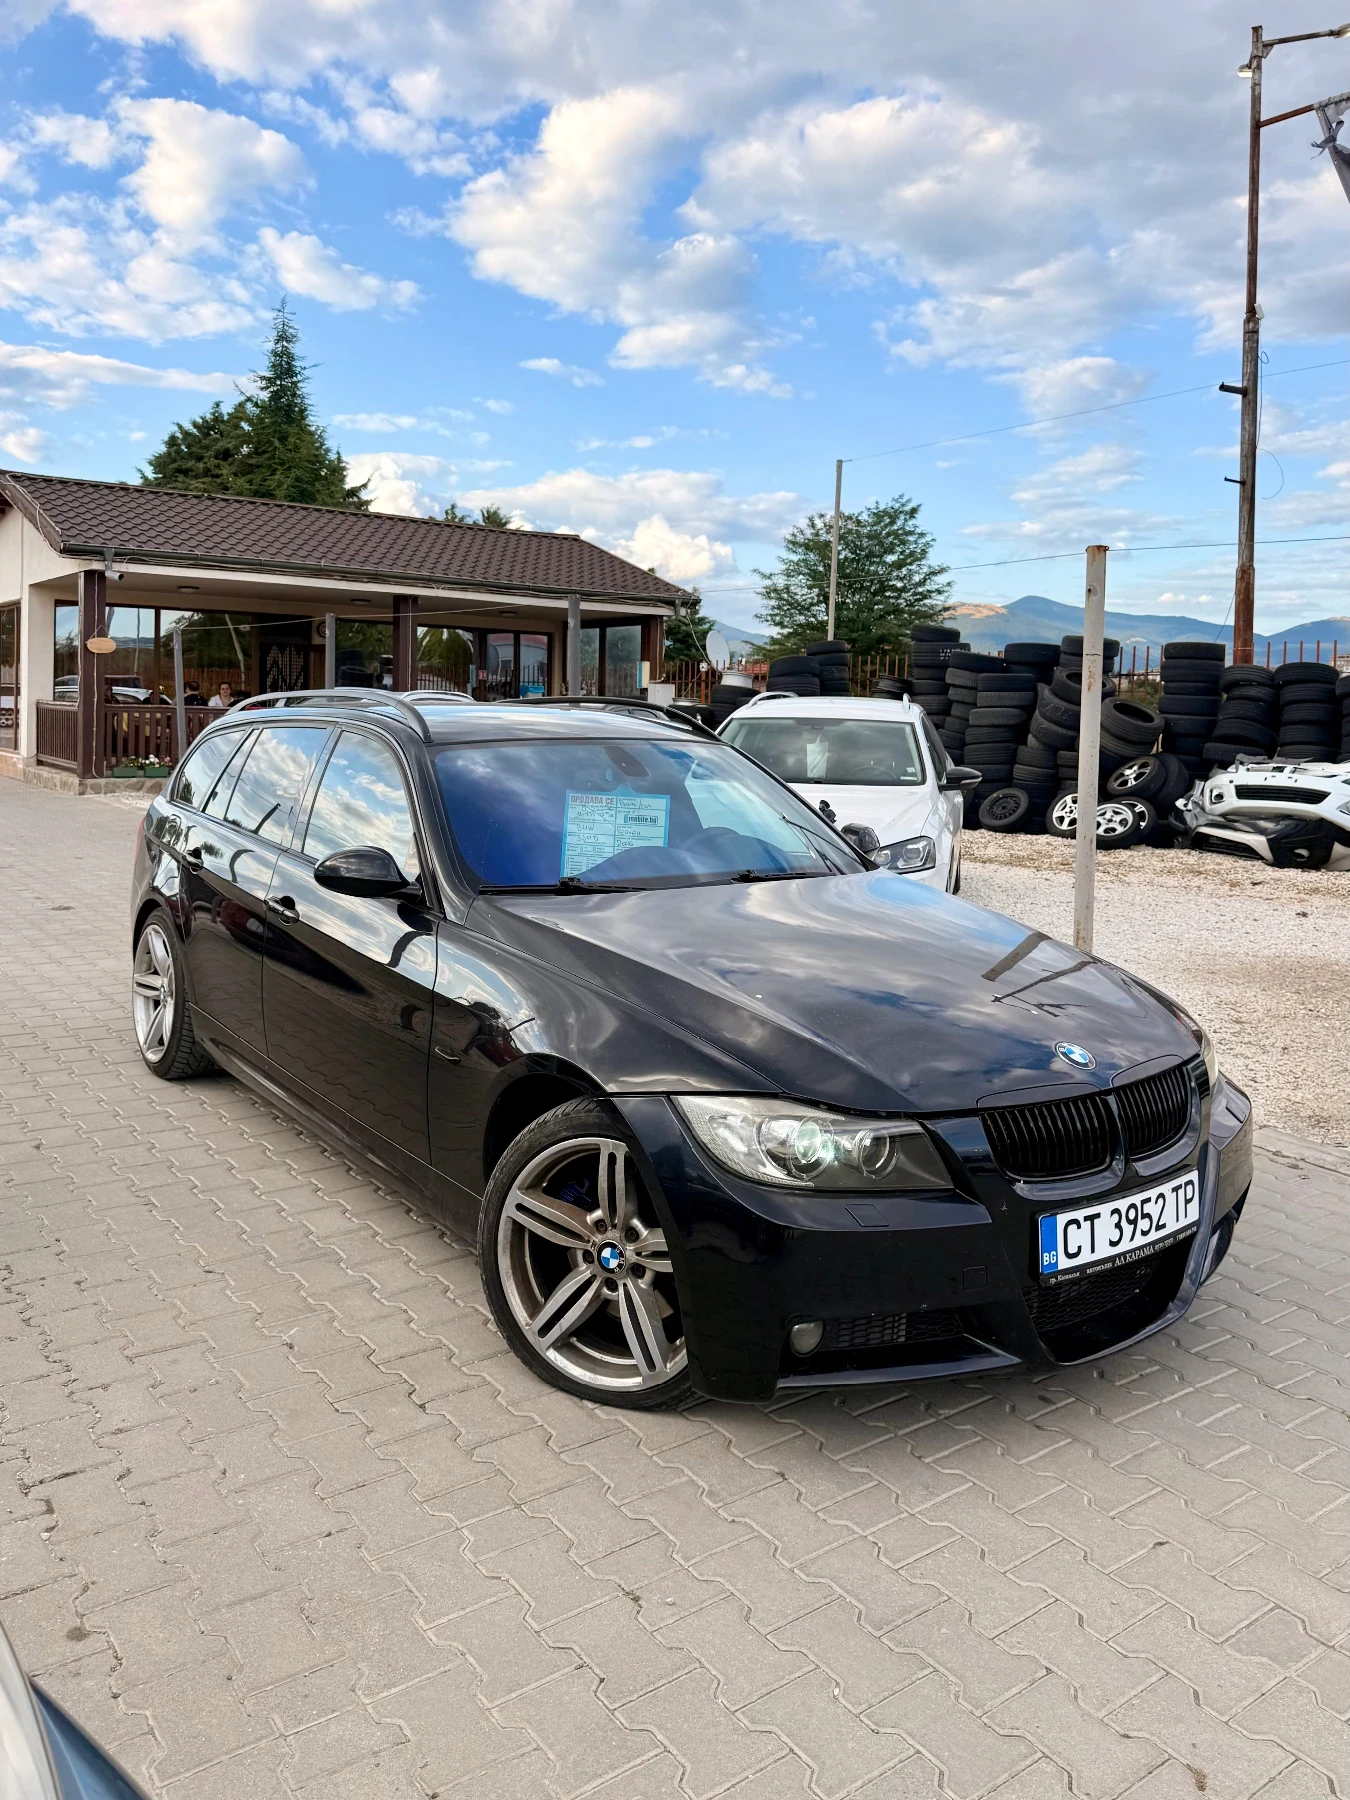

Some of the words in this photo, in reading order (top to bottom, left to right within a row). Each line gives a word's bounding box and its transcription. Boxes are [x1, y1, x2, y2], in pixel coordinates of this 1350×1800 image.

[570, 795, 604, 805] ПРОДАВА
[605, 797, 615, 805] СЕ
[628, 815, 657, 825] mobile.bg
[1062, 1213, 1101, 1260] CT
[1108, 1192, 1167, 1248] 3952
[1171, 1179, 1196, 1224] TP
[1043, 1251, 1057, 1266] BG
[1114, 1255, 1126, 1268] АЛ
[1125, 1244, 1154, 1263] КАРАМА
